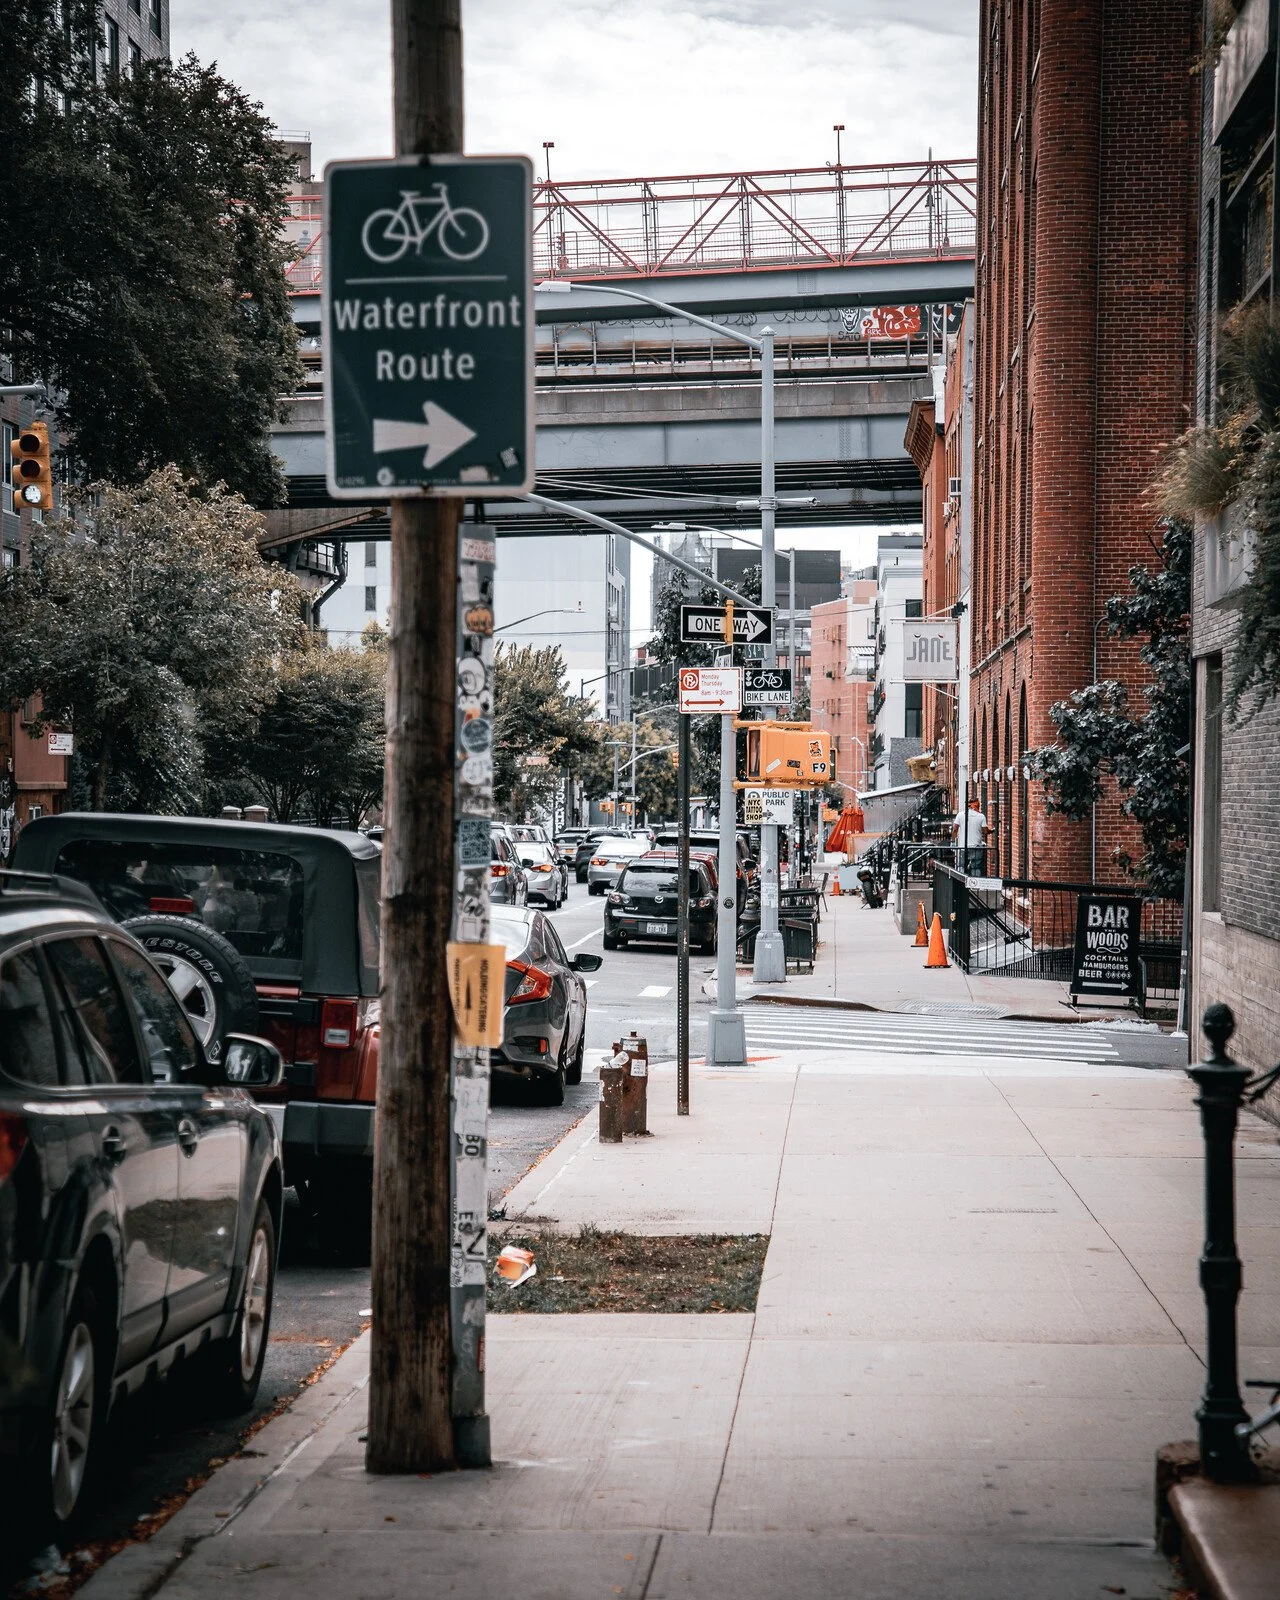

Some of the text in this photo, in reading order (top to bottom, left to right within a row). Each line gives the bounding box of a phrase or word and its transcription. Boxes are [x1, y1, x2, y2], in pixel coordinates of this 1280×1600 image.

[333, 294, 521, 332] Waterfront
[376, 348, 476, 381] Route
[695, 617, 759, 634] ONE WAY
[906, 637, 953, 663] JANE
[746, 692, 790, 702] BIKE LANE
[812, 762, 827, 773] F9
[762, 791, 790, 799] PUBLIC
[1087, 904, 1130, 929] BAR
[1086, 931, 1129, 950] WOODS
[1084, 954, 1129, 962] COCKTAILS
[1082, 962, 1129, 971] HAMBURGERS
[1078, 969, 1103, 979] BEER
